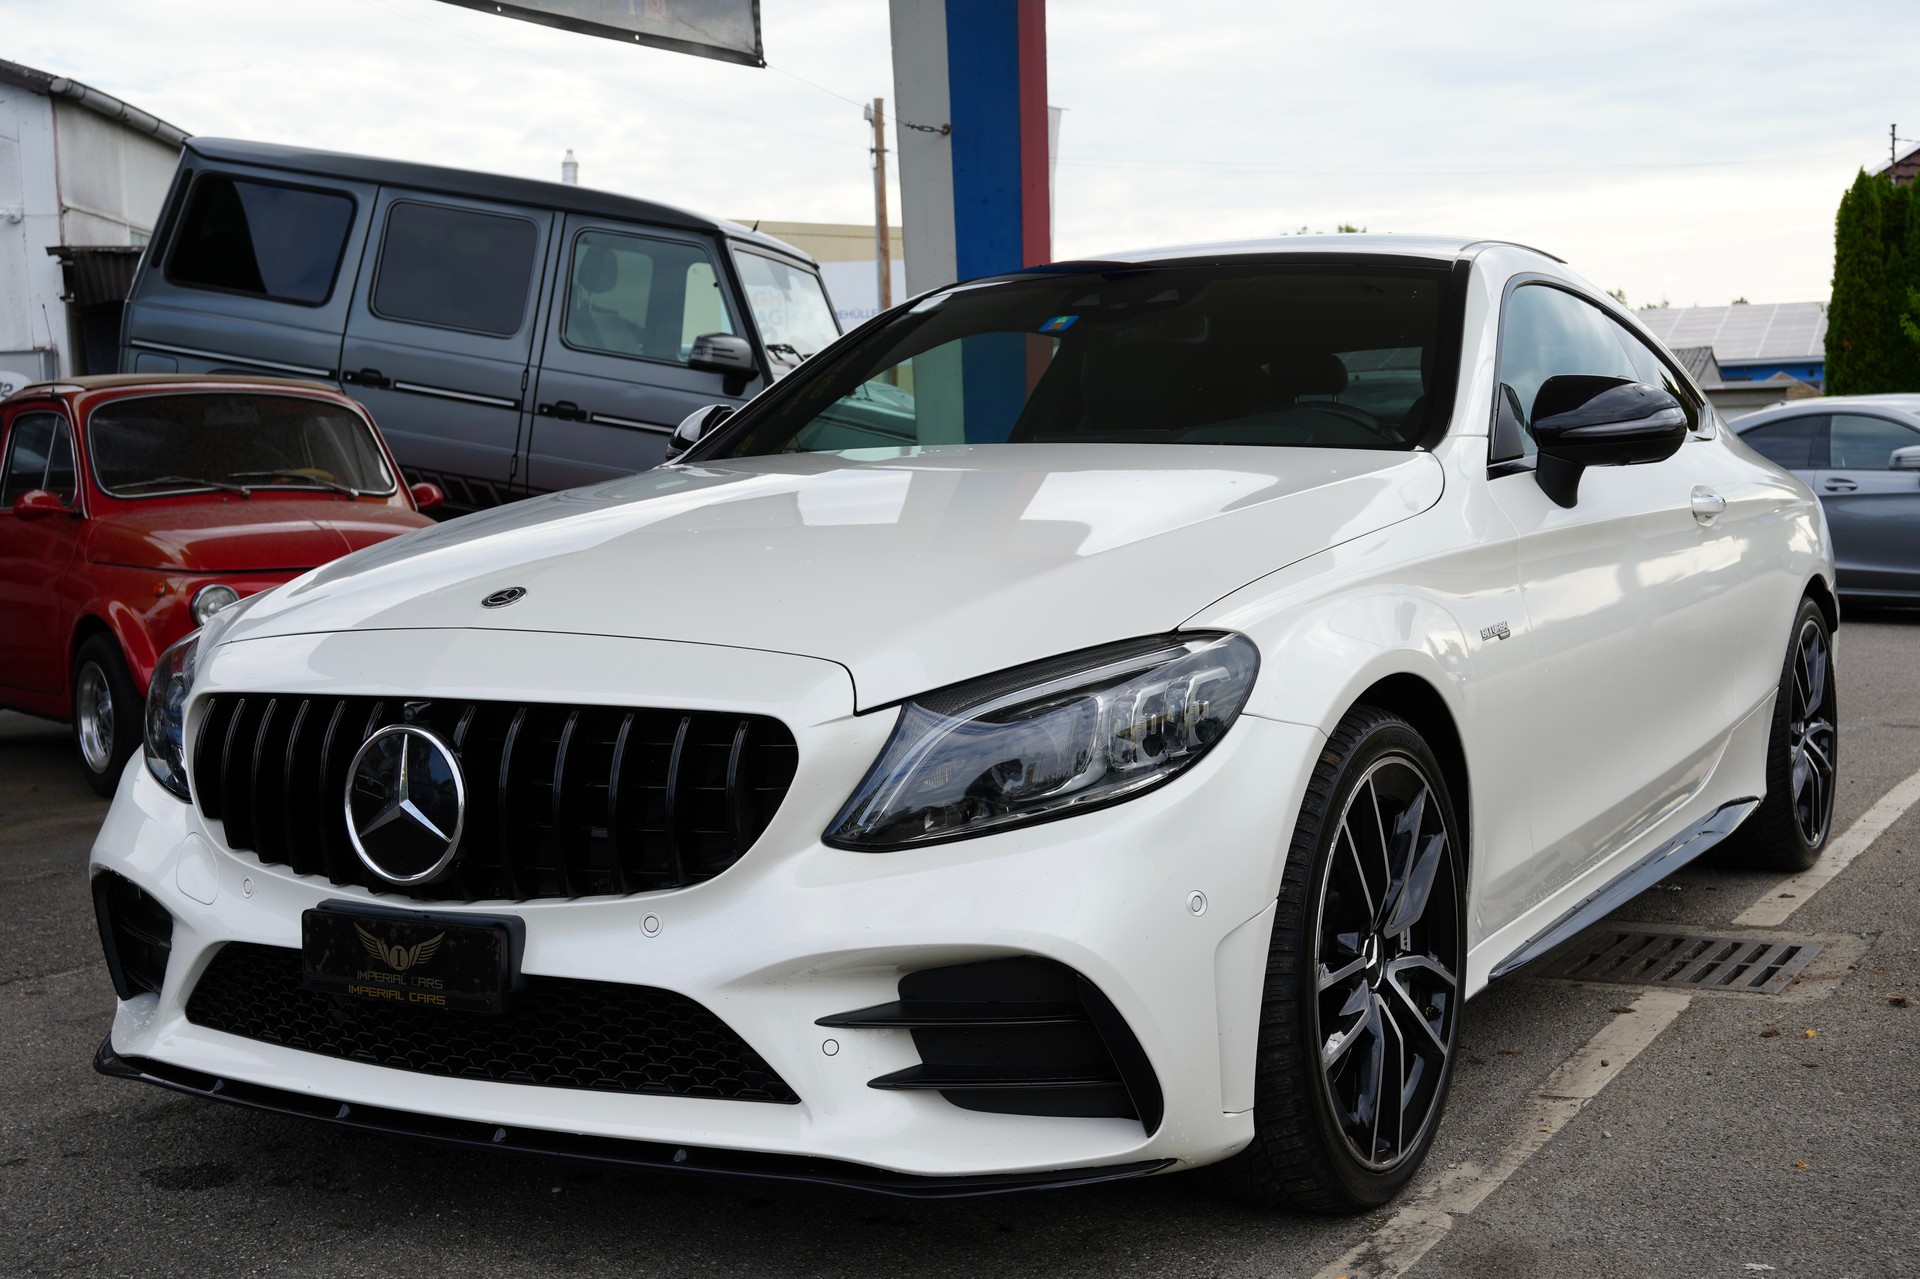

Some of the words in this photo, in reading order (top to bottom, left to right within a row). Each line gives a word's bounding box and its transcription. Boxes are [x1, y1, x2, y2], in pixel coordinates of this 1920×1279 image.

[357, 969, 407, 986] IMPERIAL
[410, 976, 444, 990] CARS
[348, 984, 405, 1001] IMPERIAL
[408, 991, 446, 1006] CARS
